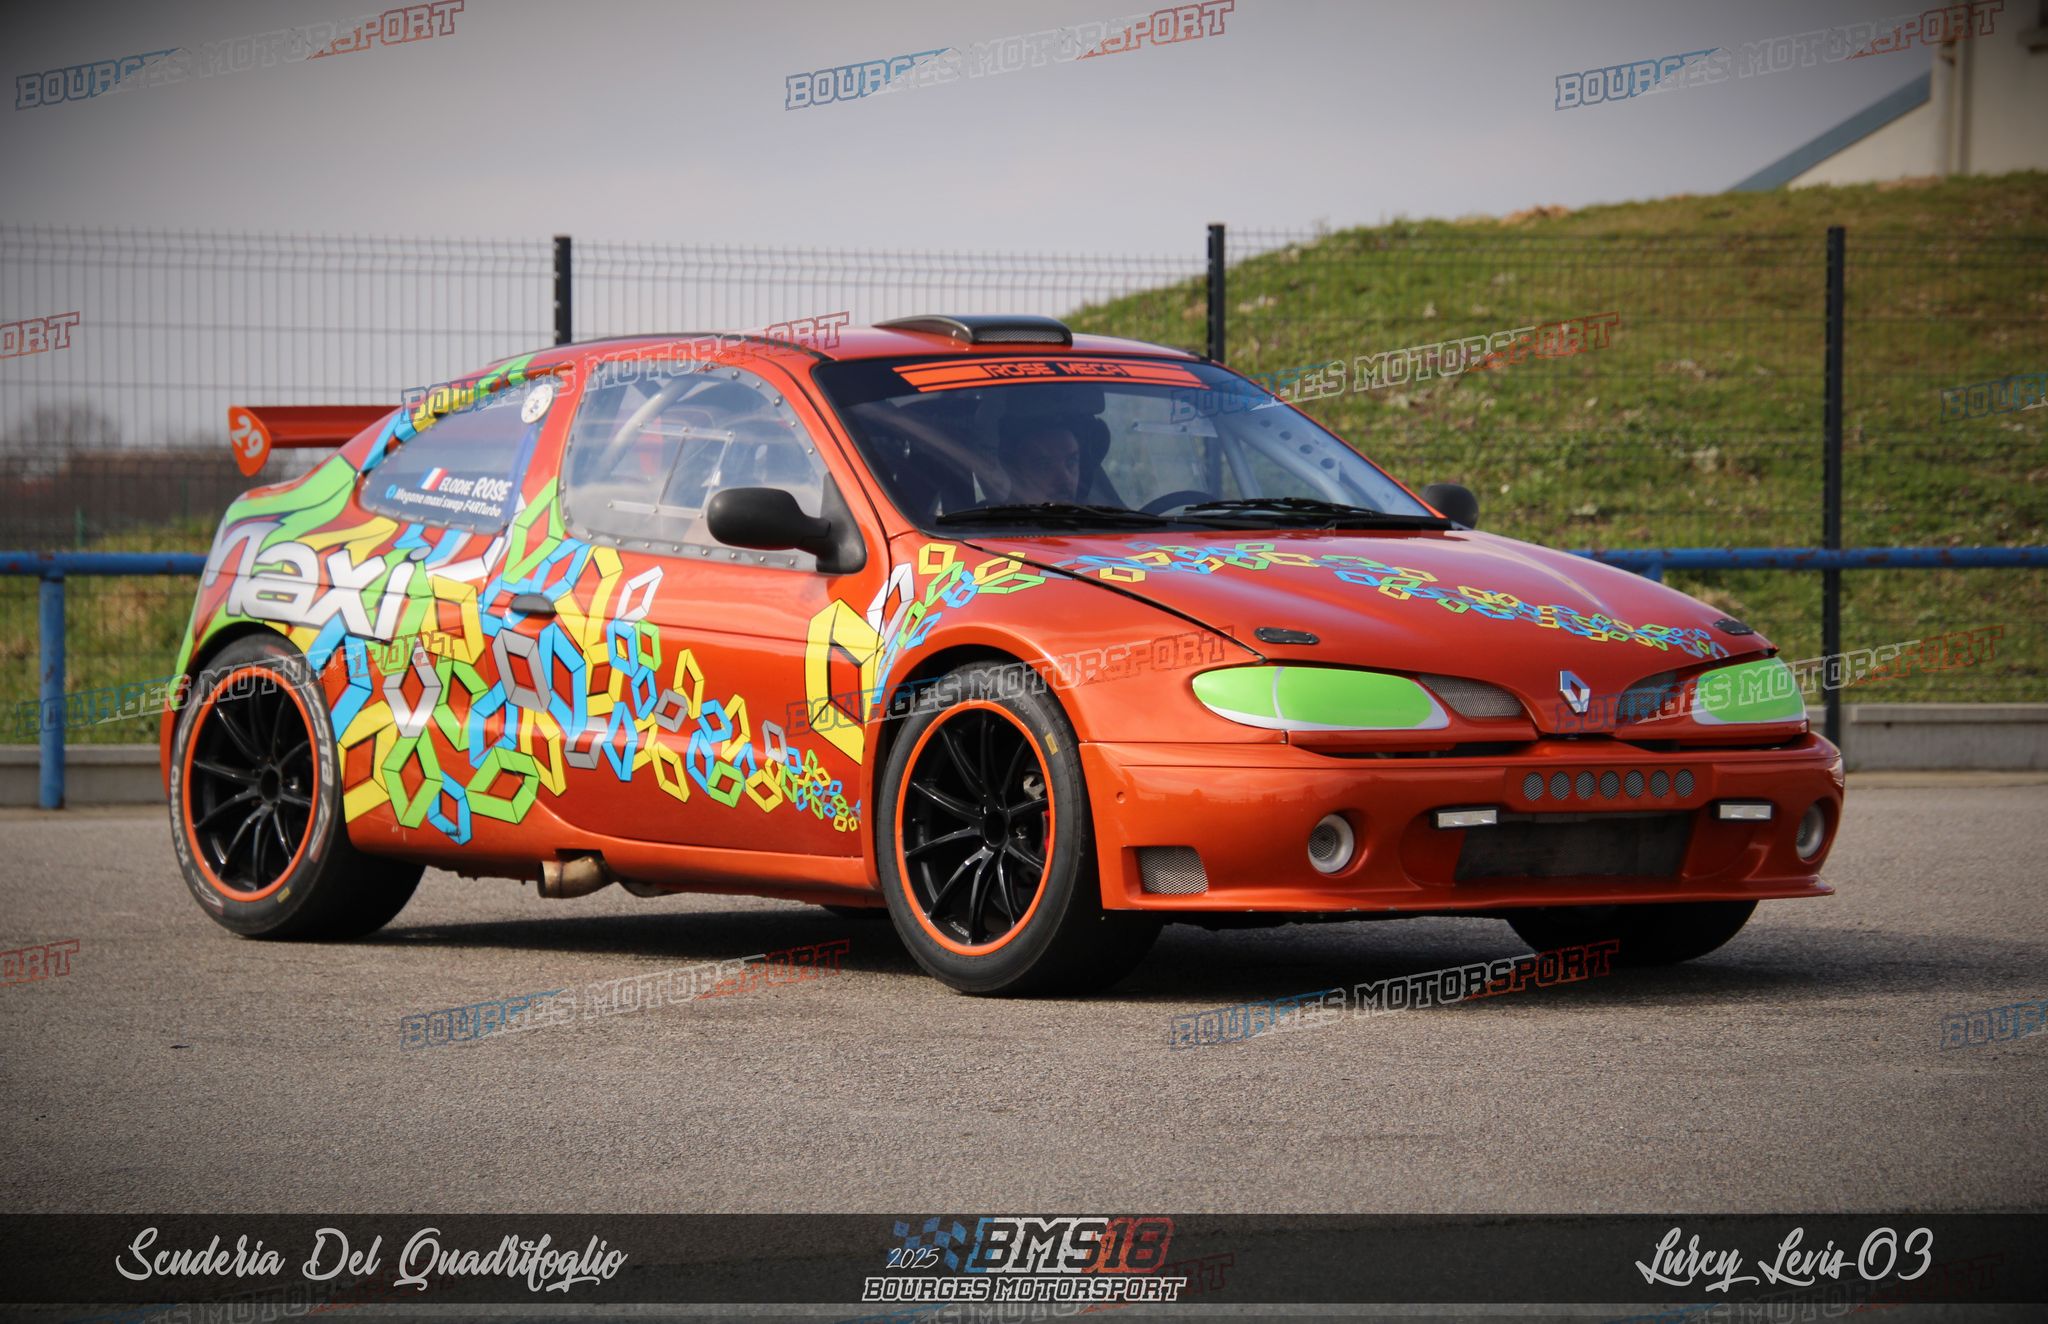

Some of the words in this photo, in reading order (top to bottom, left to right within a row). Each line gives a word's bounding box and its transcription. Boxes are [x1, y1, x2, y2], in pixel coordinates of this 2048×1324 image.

[982, 362, 1056, 377] ROSE
[1056, 362, 1128, 376] MECA
[231, 414, 266, 458] 29
[438, 477, 475, 495] ELODIE
[472, 477, 513, 502] ROSE
